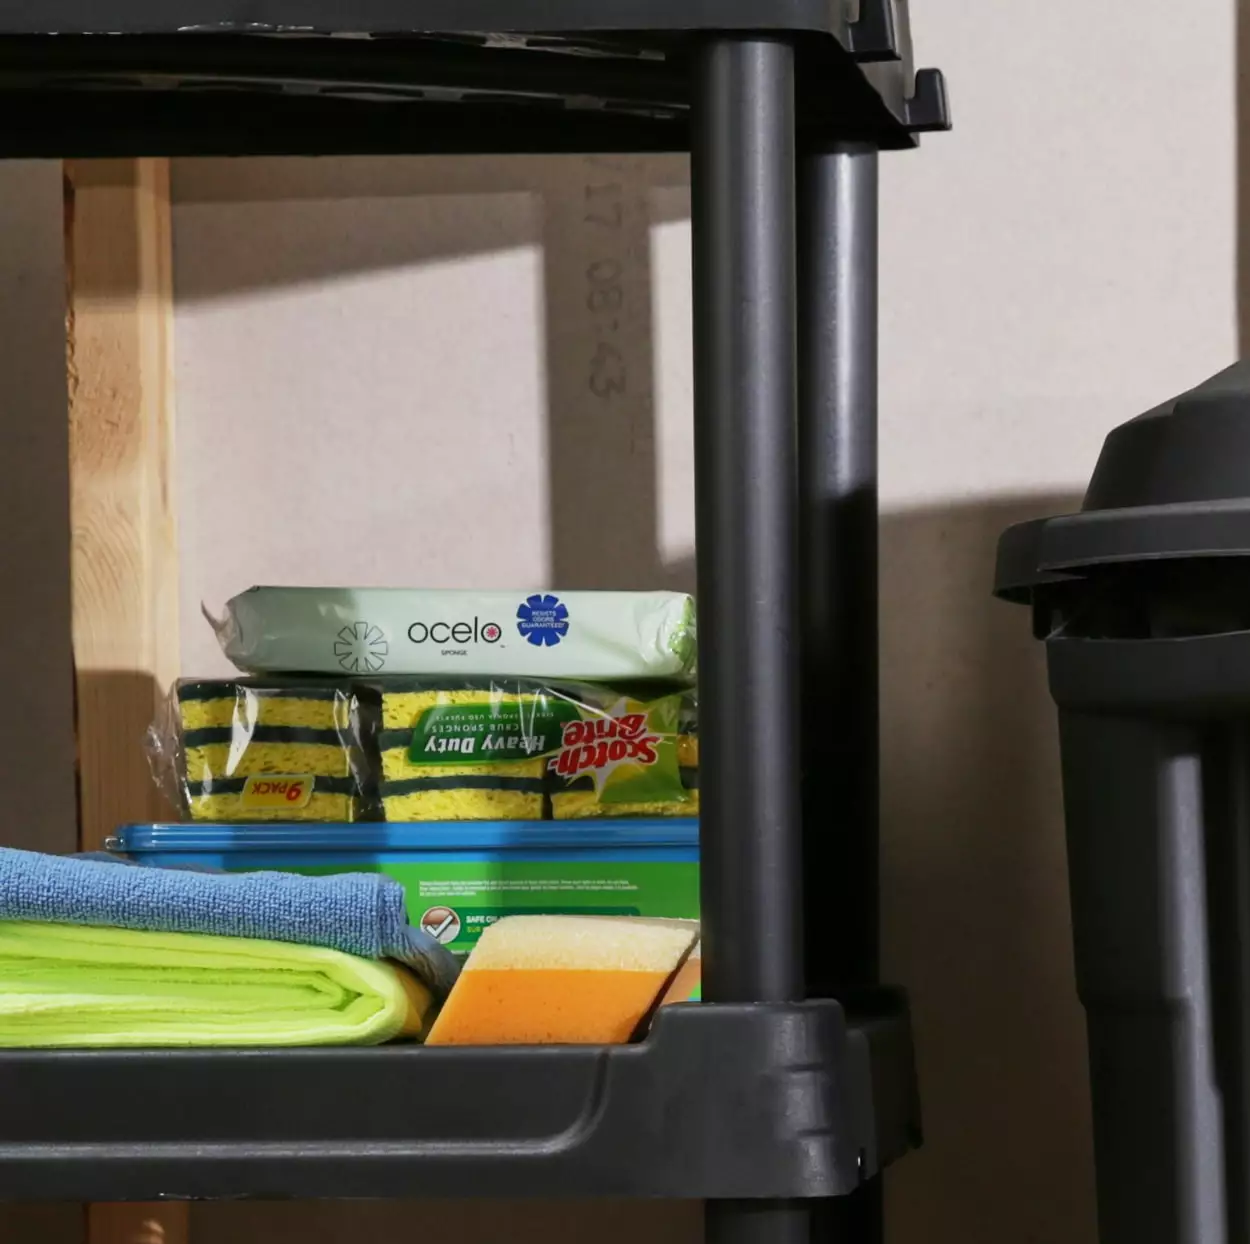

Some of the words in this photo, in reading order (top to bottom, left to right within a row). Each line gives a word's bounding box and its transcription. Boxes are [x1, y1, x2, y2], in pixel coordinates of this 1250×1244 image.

[407, 616, 502, 643] ocelo
[432, 724, 484, 732] SPONGES
[488, 722, 522, 732] CRUB
[564, 714, 648, 747] Brite
[424, 734, 475, 754] Duty
[481, 734, 545, 754] Heavy
[252, 782, 288, 794] PACK
[466, 915, 484, 924] SAFE
